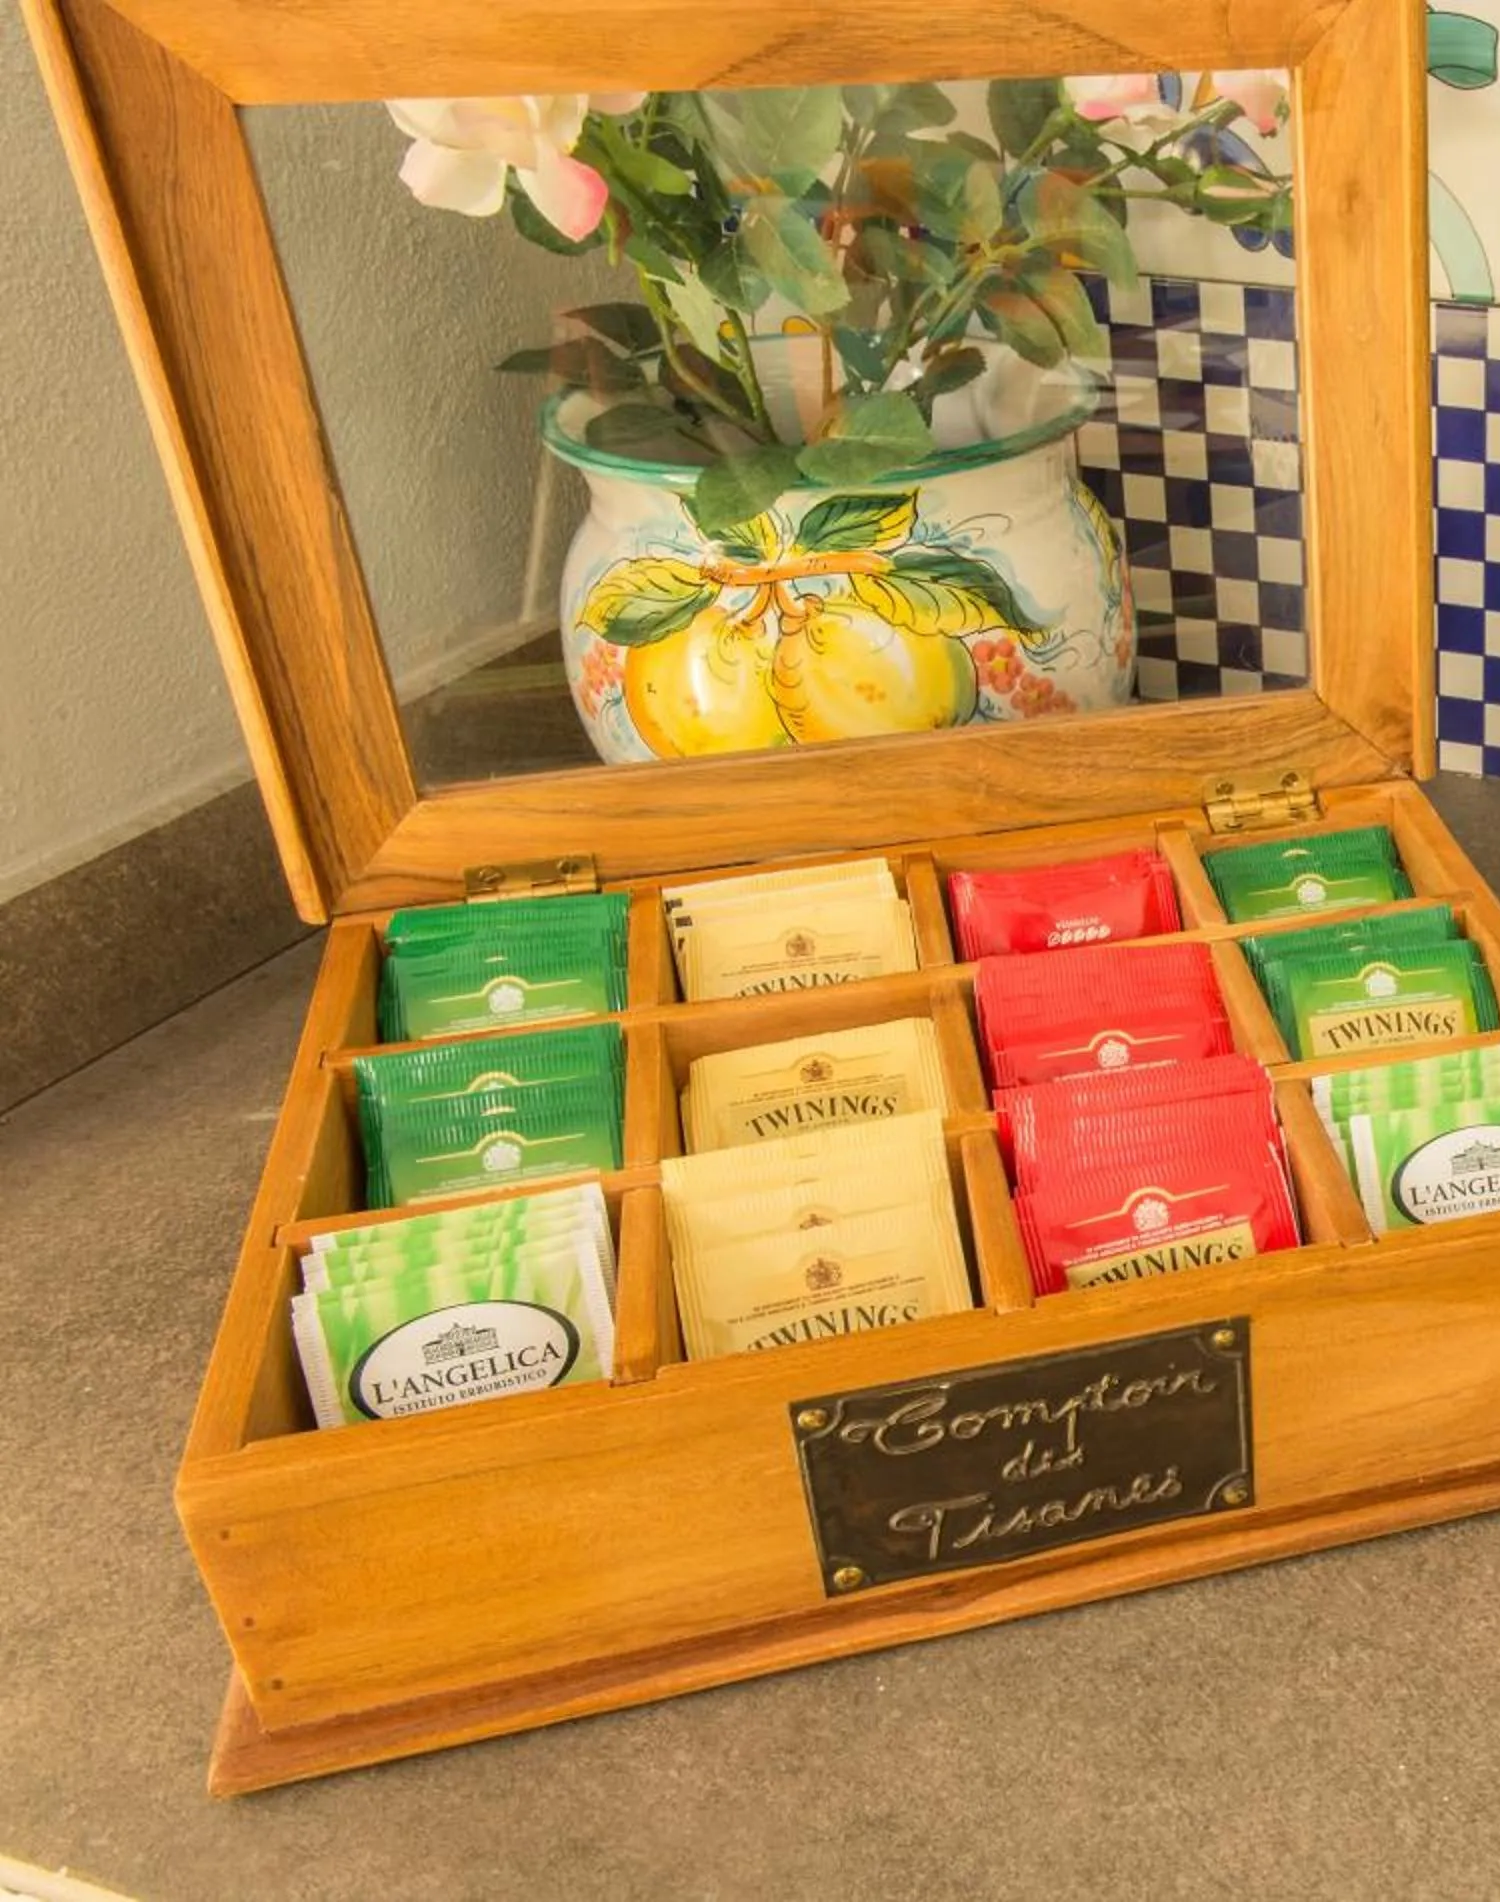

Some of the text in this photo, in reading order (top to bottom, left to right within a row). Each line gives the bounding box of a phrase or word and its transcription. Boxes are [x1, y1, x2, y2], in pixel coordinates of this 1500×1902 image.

[735, 972, 861, 999] WININ
[1322, 1010, 1456, 1049] TWININGS
[745, 1094, 898, 1137] TWININGS
[372, 1341, 561, 1405] L'ANGELICA
[392, 1393, 456, 1415] ISTITUTO
[889, 1465, 1183, 1561] Tisanes
